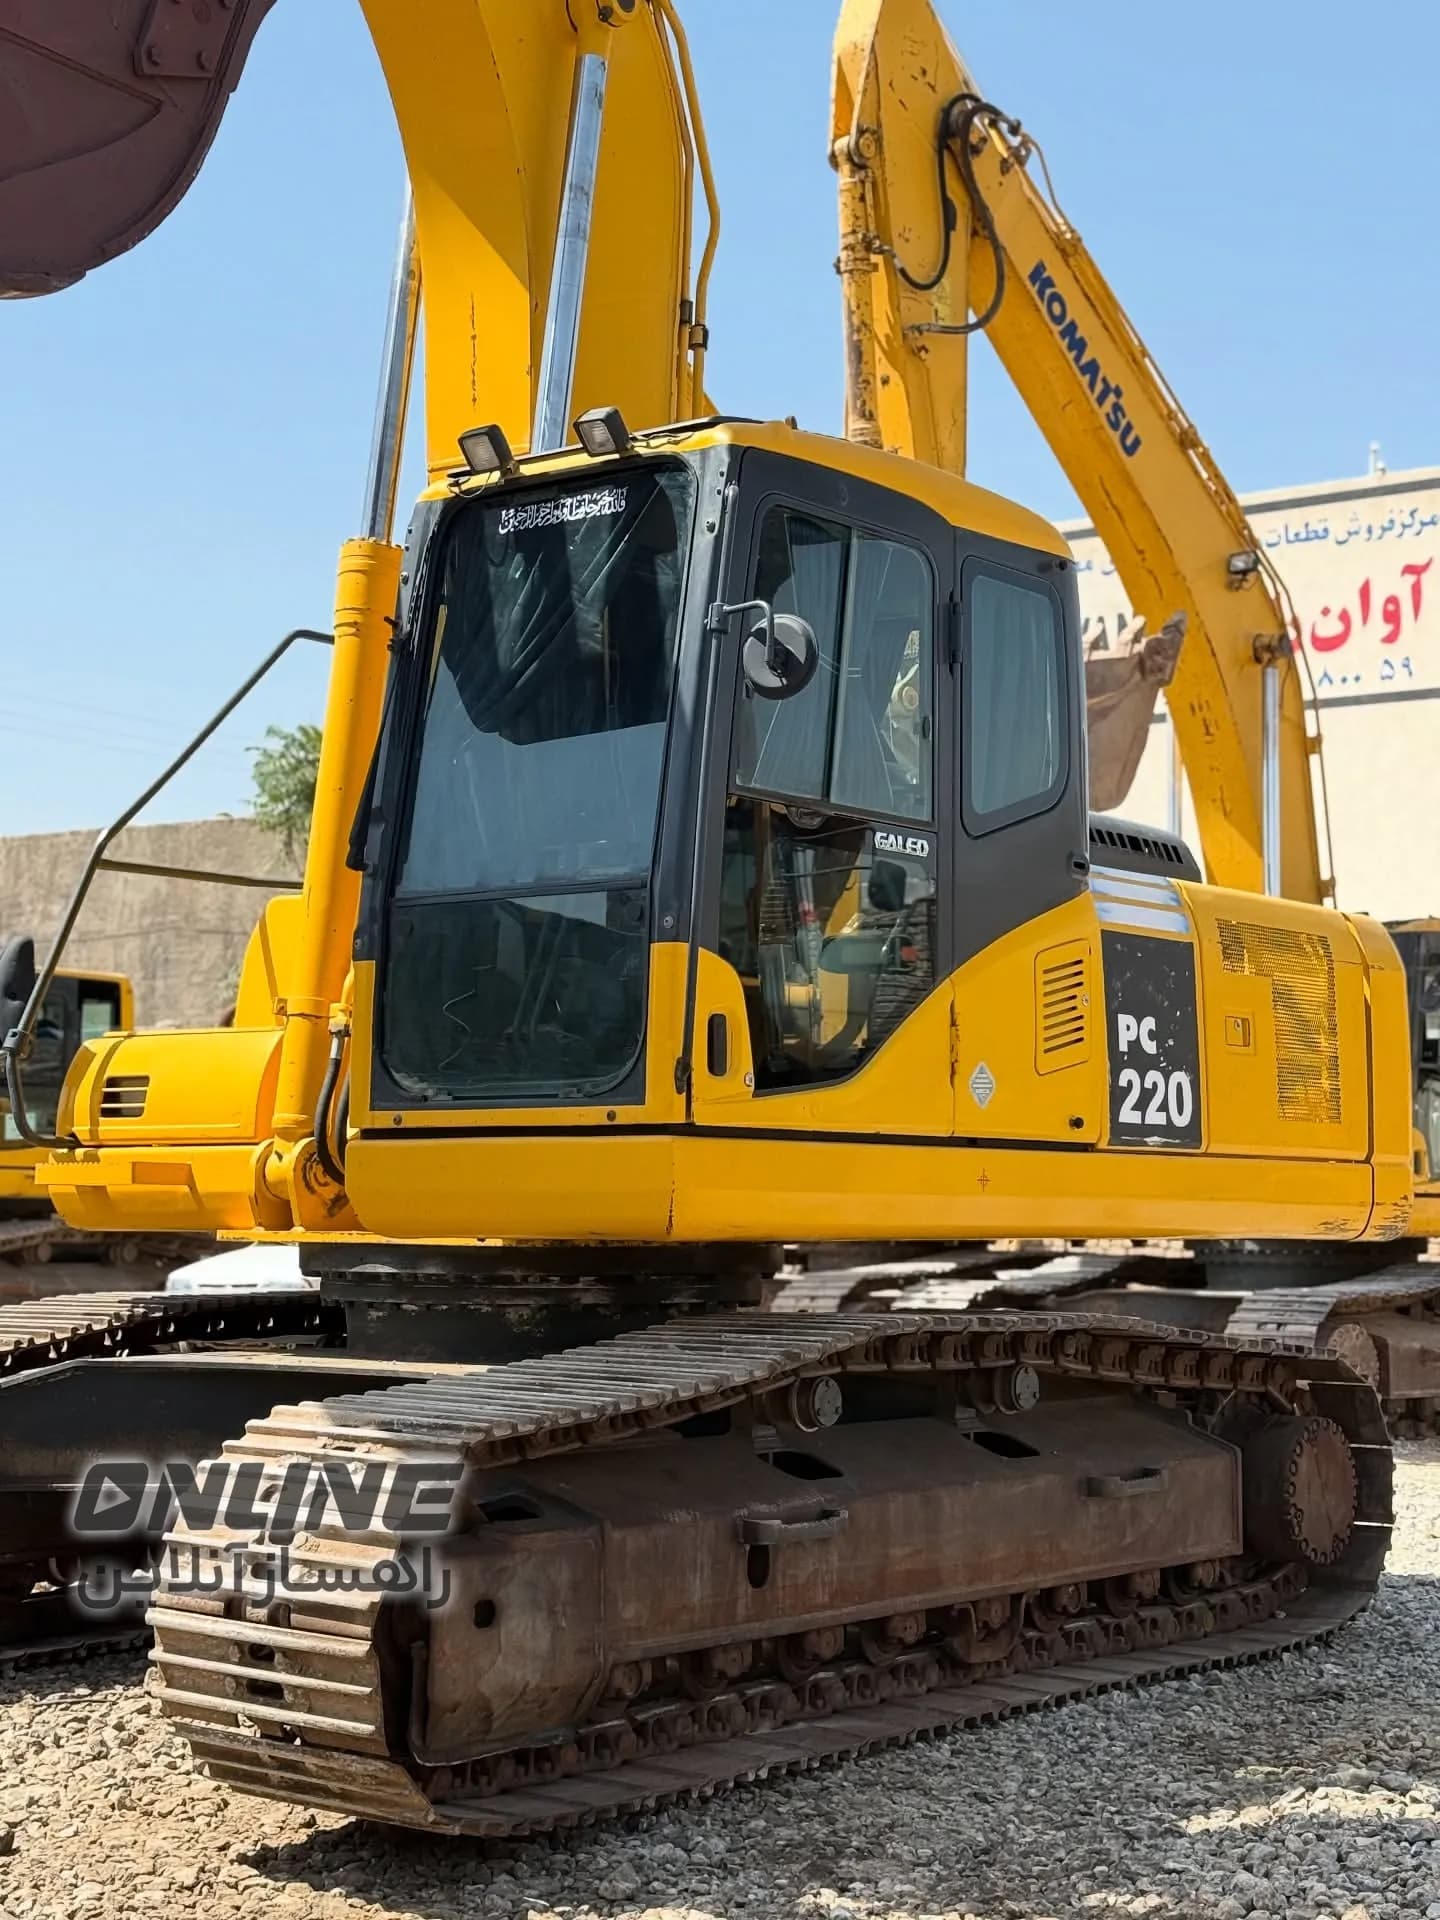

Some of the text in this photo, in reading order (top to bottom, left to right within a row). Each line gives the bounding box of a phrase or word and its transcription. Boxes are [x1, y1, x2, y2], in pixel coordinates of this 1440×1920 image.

[1028, 259, 1142, 458] KOMATSU
[1265, 518, 1330, 548] قطعات
[1310, 556, 1433, 653] آوان
[1117, 1013, 1157, 1055] PC
[1118, 1068, 1193, 1127] 220
